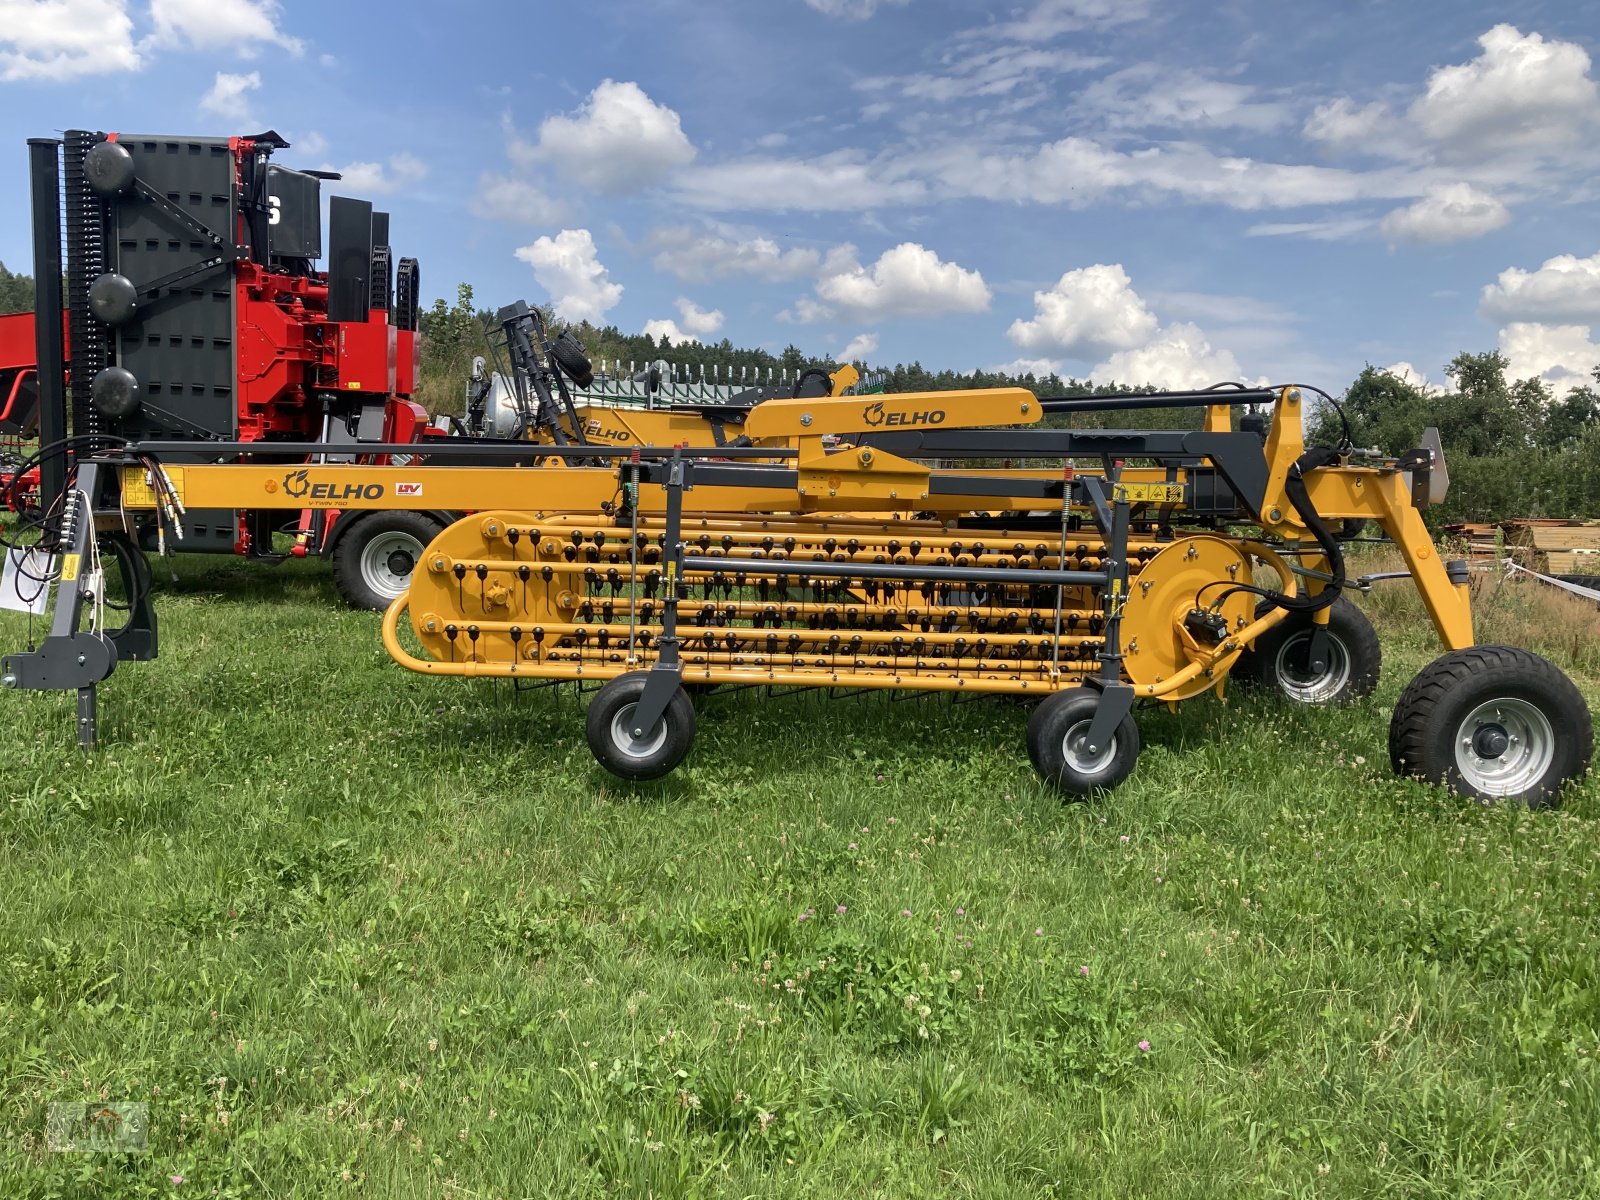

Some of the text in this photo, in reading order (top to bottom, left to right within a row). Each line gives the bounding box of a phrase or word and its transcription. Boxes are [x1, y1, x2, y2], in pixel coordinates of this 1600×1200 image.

[885, 410, 946, 426] ELHO
[585, 425, 631, 441] ELHO
[309, 483, 385, 500] ELHO
